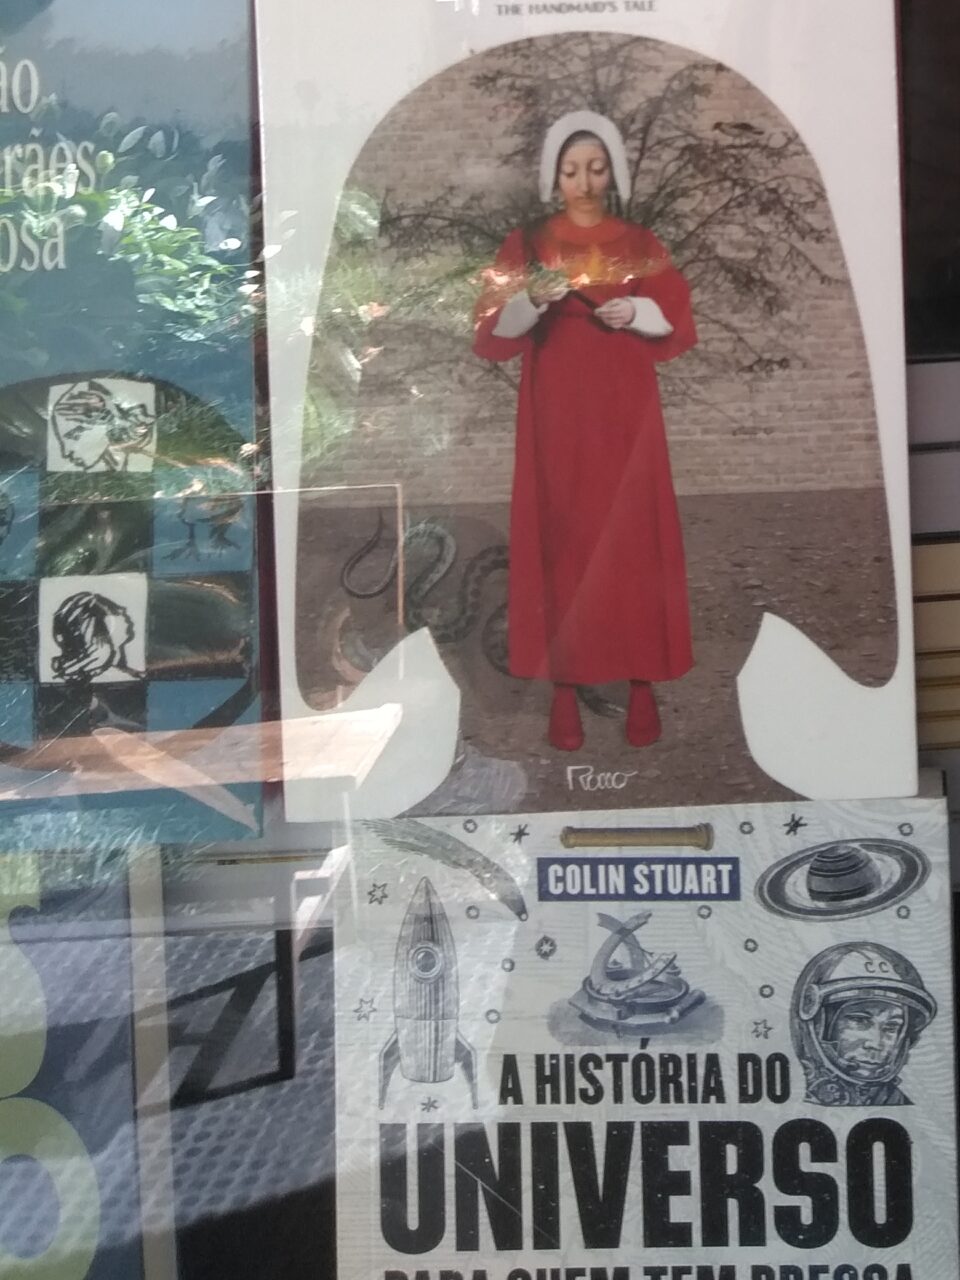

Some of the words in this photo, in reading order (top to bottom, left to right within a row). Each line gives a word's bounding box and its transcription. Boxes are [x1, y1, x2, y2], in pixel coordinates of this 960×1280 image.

[496, 4, 522, 16] THE
[624, 0, 658, 13] TALE
[548, 865, 625, 895] COLIN
[633, 863, 734, 896] STUART
[499, 1053, 523, 1105] A
[536, 1037, 726, 1104] HISTÓRIA
[739, 1052, 791, 1104] DO
[378, 1117, 915, 1255] UNIVERSO
